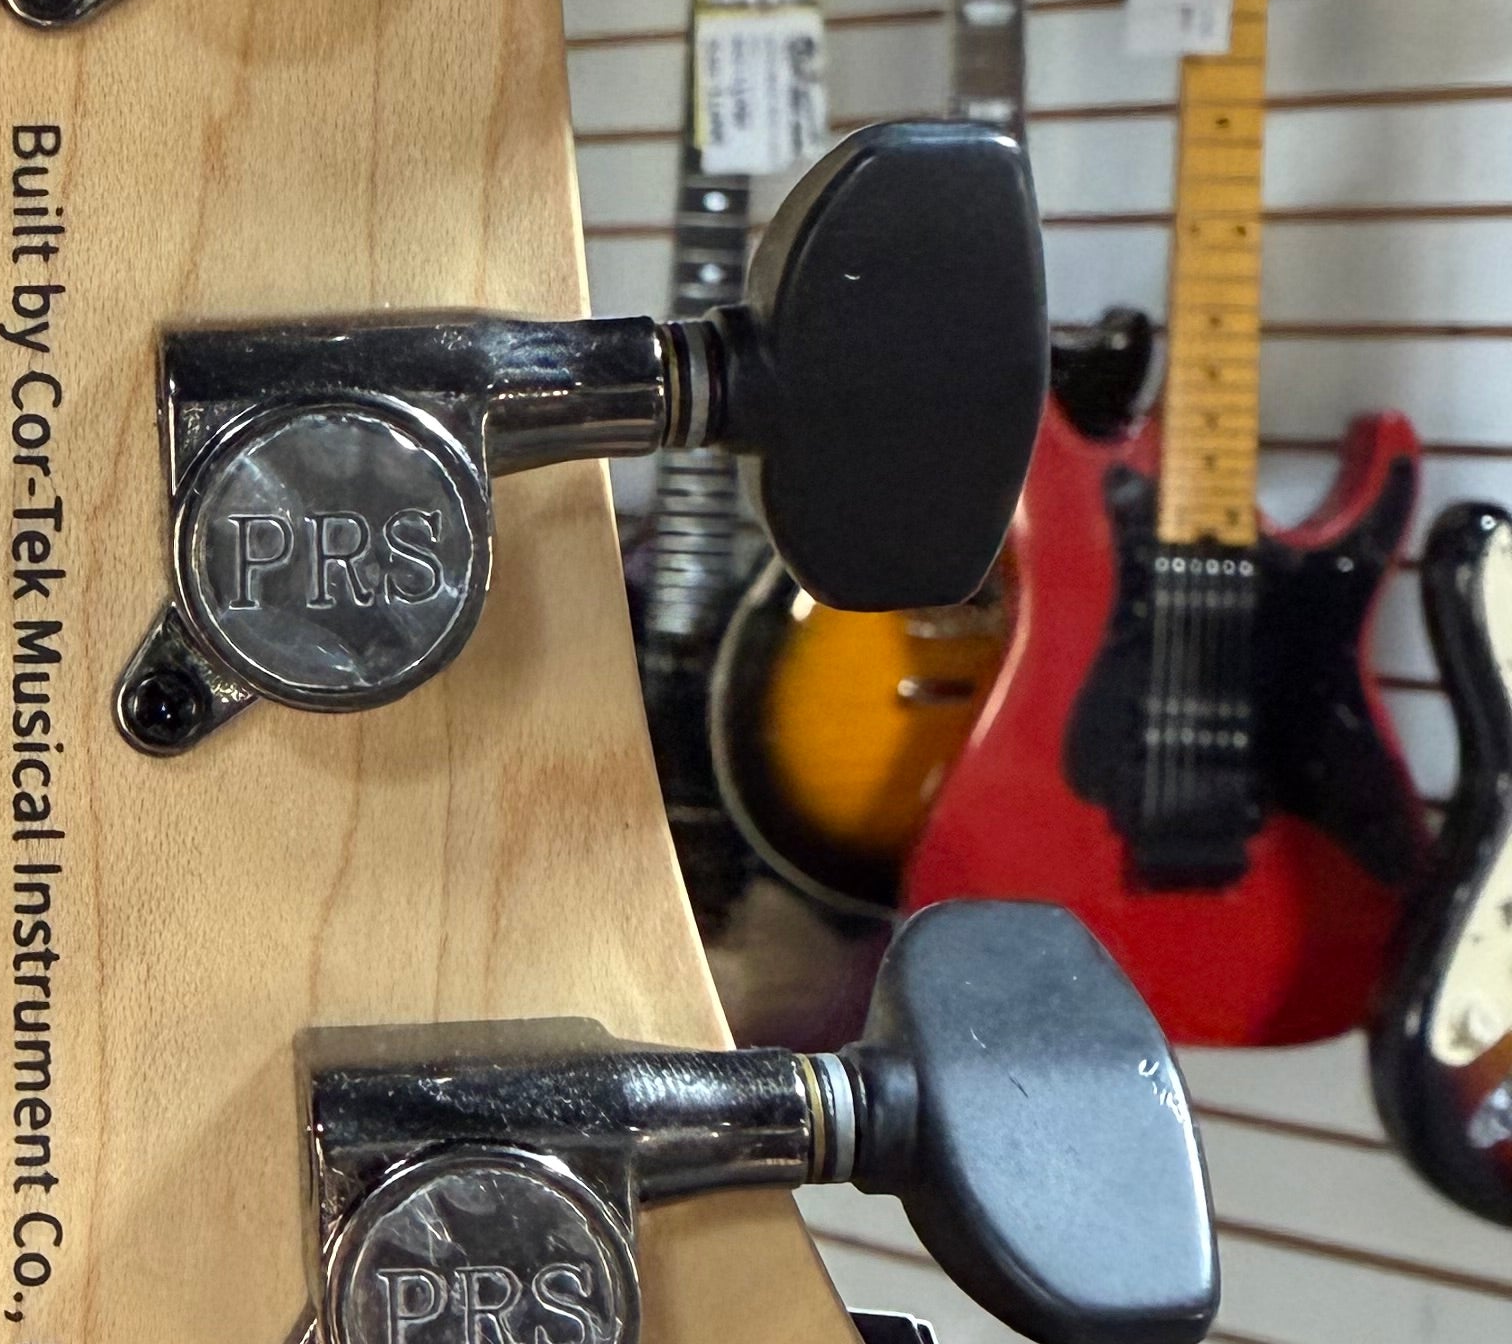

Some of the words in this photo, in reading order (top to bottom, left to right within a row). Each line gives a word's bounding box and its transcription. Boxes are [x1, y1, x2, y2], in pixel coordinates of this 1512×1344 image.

[11, 125, 65, 264] Built
[11, 370, 66, 600] Cor-Tek
[227, 508, 442, 611] PRS
[11, 621, 66, 841] Musical
[12, 864, 62, 1194] Instrument
[4, 1212, 64, 1322] Co.,
